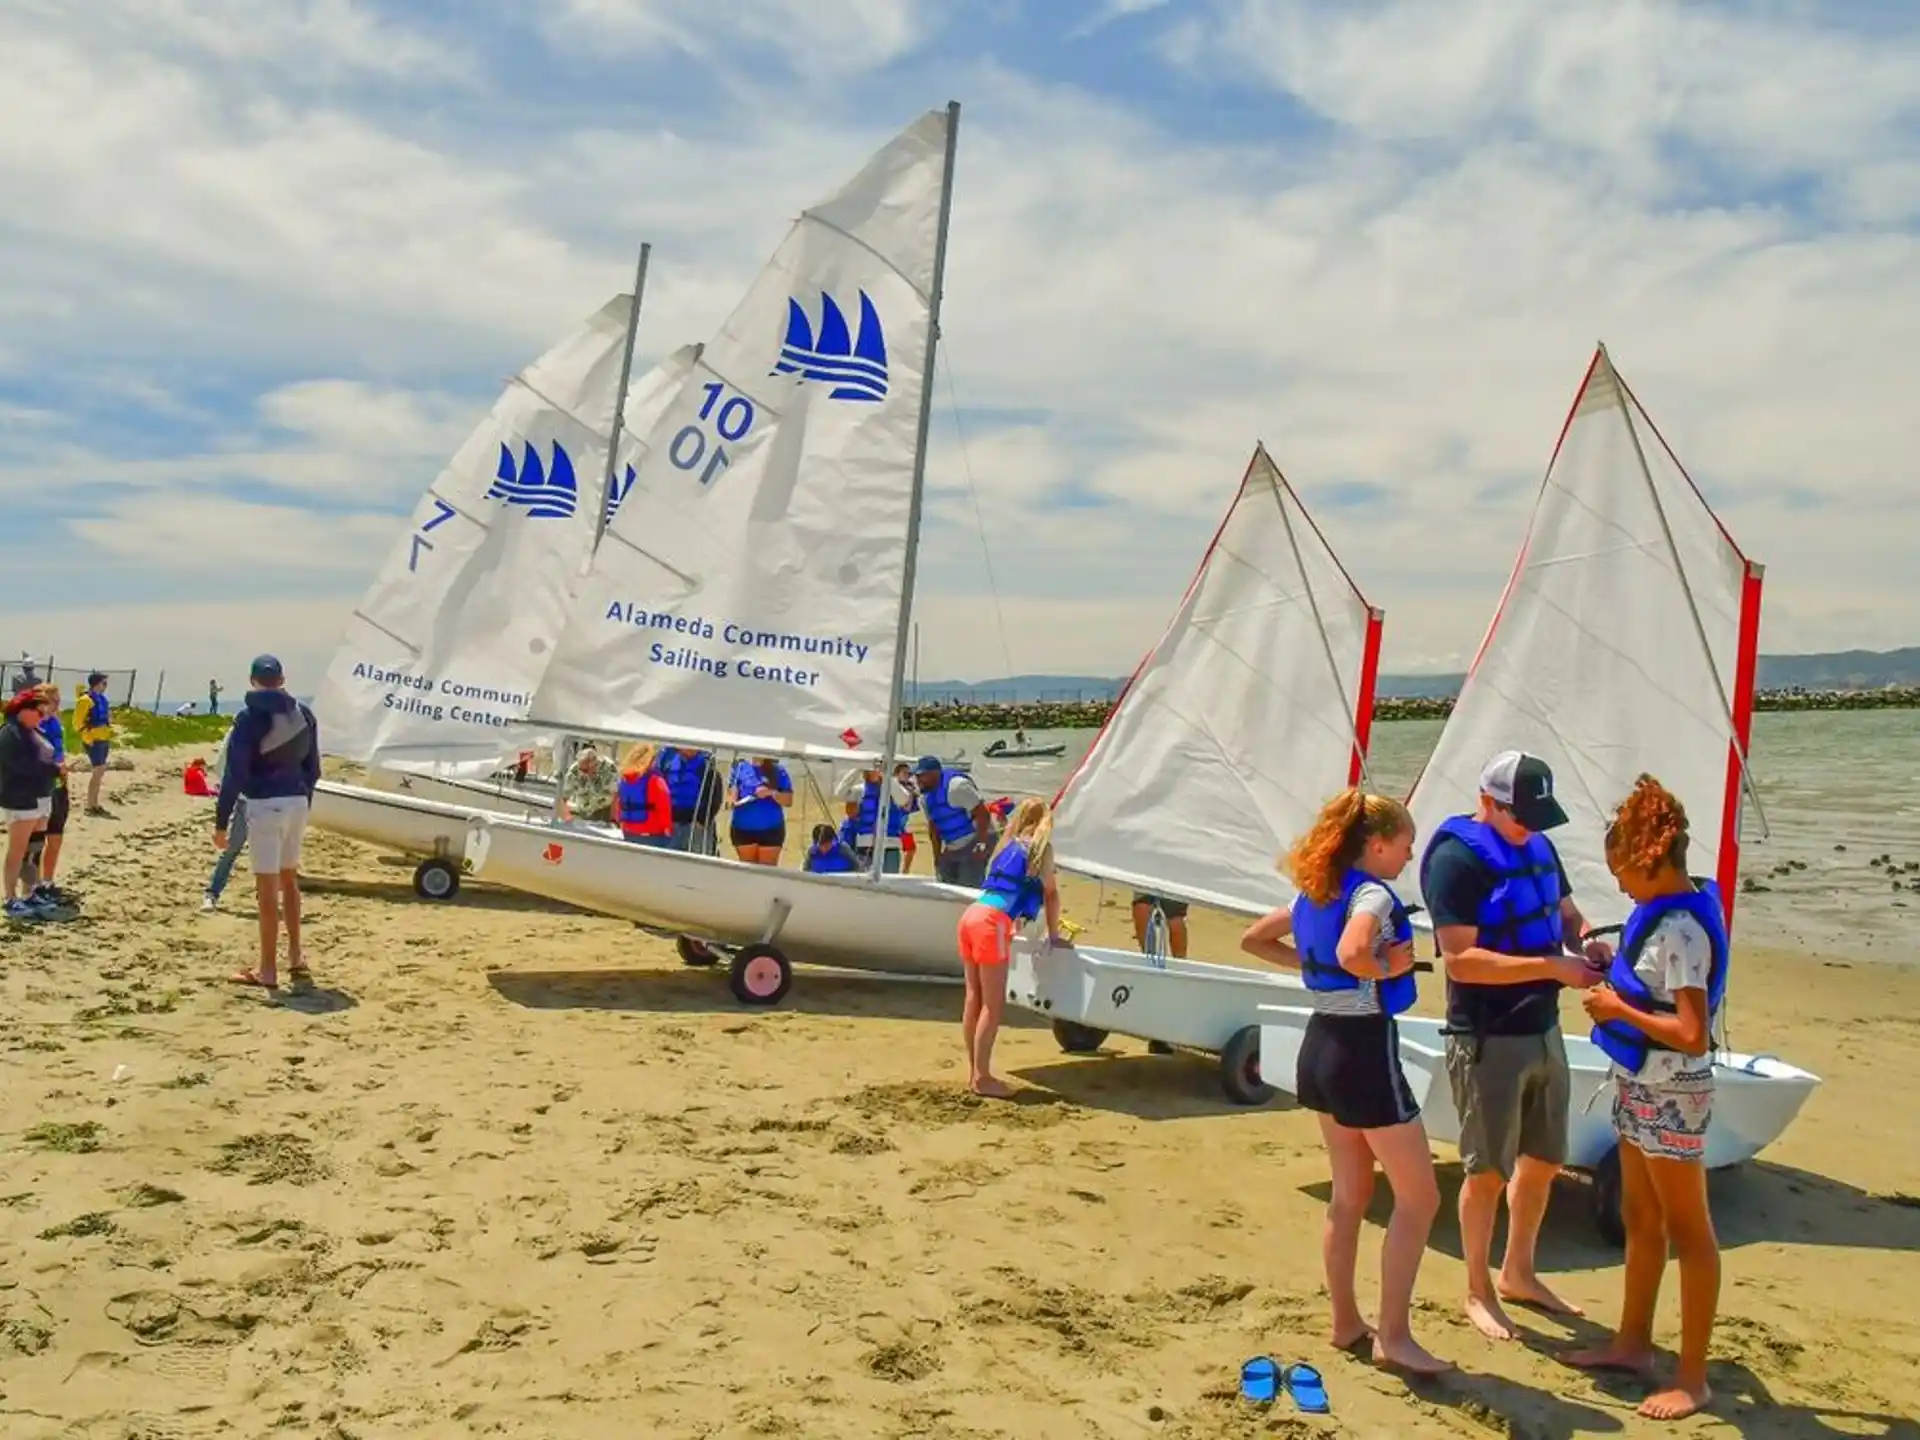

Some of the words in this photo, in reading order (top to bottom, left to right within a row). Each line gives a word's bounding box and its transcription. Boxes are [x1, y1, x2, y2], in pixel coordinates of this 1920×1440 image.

[699, 383, 753, 441] 10
[422, 500, 456, 532] 7
[606, 601, 714, 640] Alameda
[723, 624, 868, 664] Community
[352, 662, 434, 691] Alameda
[441, 679, 531, 706] Communi
[650, 643, 728, 678] Sailing
[737, 660, 820, 687] Center
[384, 693, 444, 722] Sailing
[450, 705, 511, 728] Center
